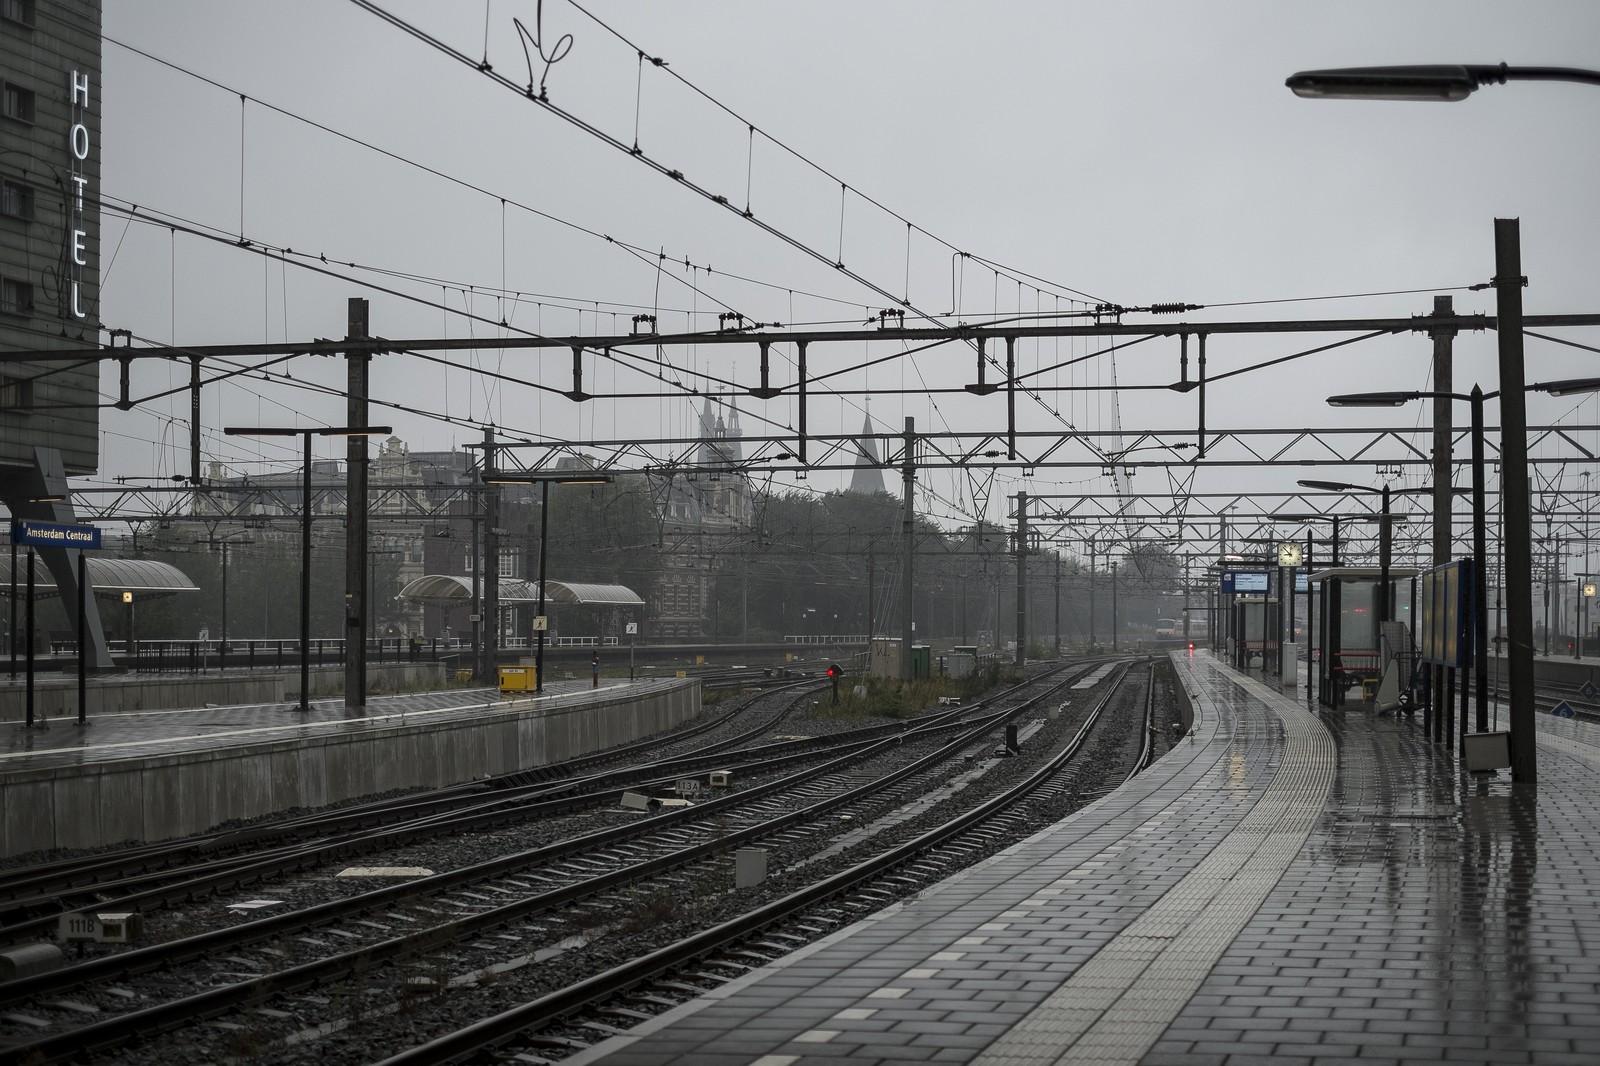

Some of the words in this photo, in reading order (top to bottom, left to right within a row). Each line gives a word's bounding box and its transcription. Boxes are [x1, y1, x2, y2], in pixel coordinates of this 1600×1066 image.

[70, 69, 90, 318] HOTEL
[26, 527, 65, 540] Amsterdam
[65, 530, 93, 541] Centraal
[1559, 708, 1568, 718] 6
[677, 781, 698, 791] 113A
[69, 919, 95, 933] 111B
